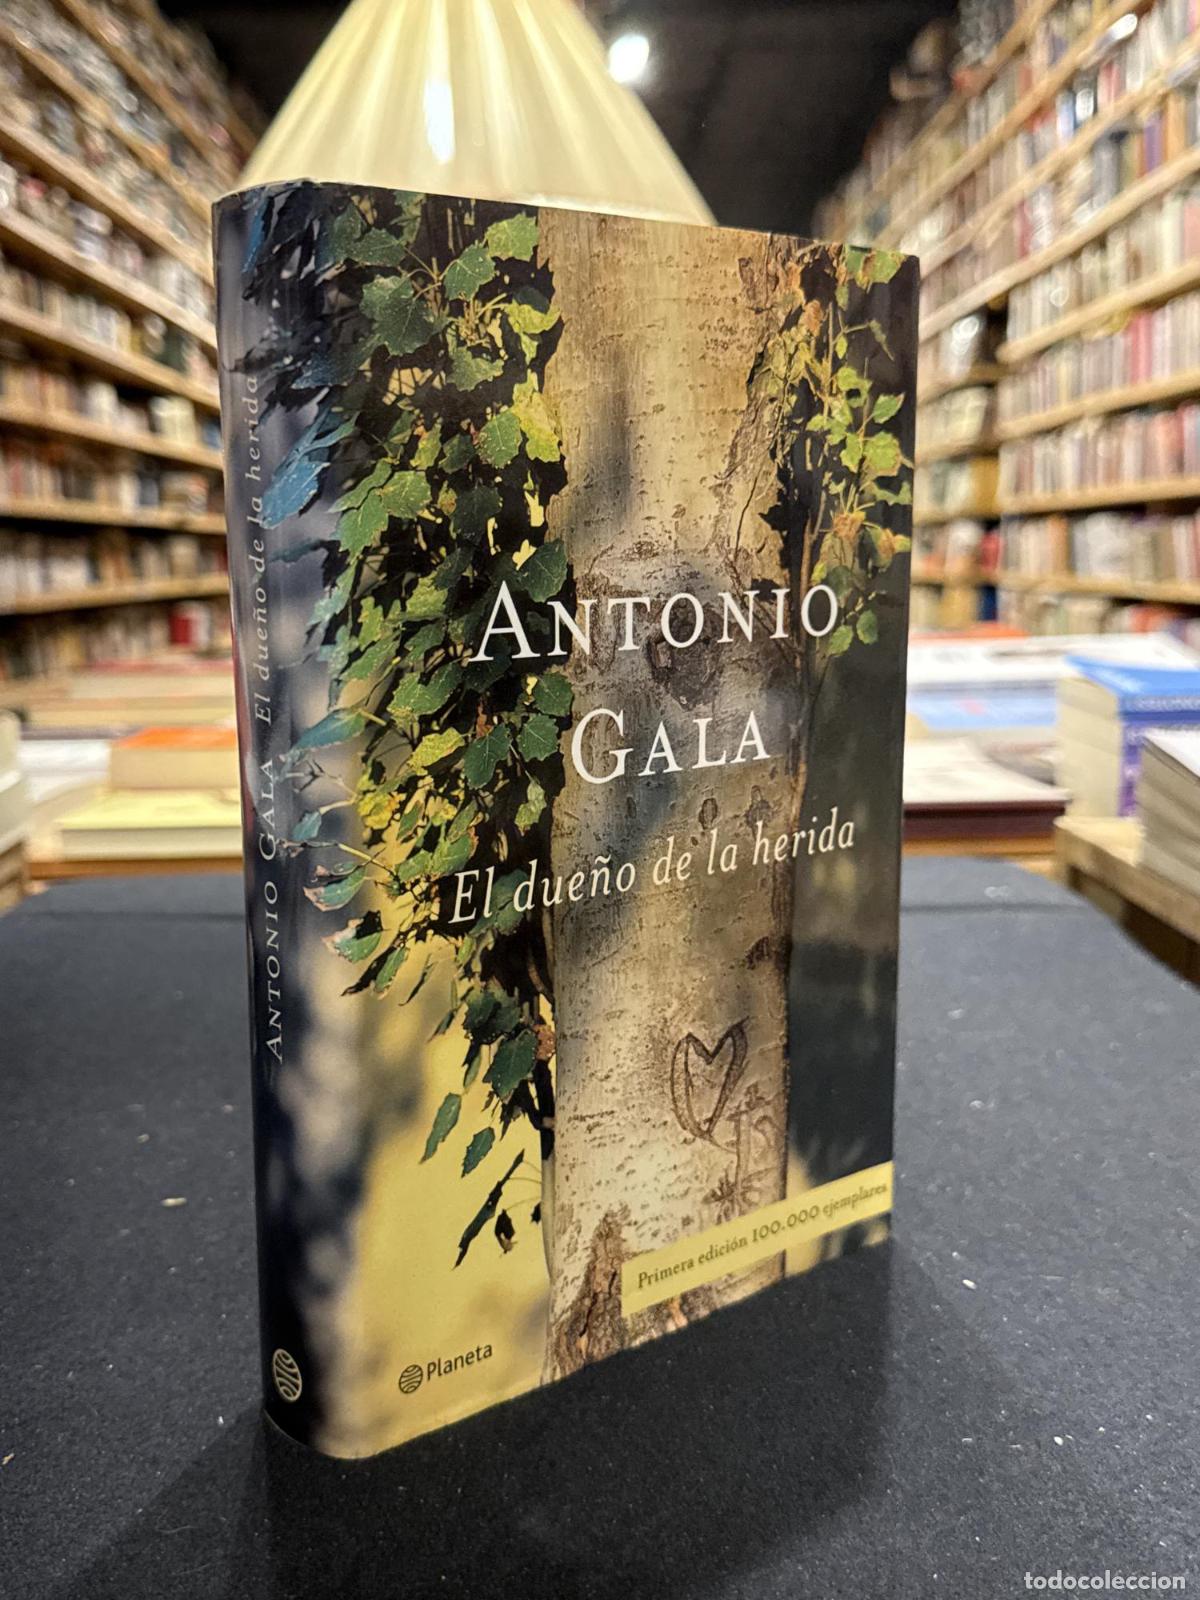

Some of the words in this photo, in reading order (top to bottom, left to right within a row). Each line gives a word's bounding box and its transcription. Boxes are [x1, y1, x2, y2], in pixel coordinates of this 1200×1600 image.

[245, 376, 262, 482] herida
[248, 539, 265, 573] de
[252, 588, 270, 681] dueño
[255, 692, 272, 725] El
[259, 759, 276, 861] GALA
[448, 868, 494, 924] El
[513, 855, 636, 913] dueño
[652, 836, 691, 886] de
[706, 829, 738, 875] la
[752, 806, 855, 866] herida
[265, 881, 283, 1064] ANTONIO
[637, 1258, 695, 1288] Primera
[697, 1236, 748, 1266] edición
[822, 1183, 888, 1218] ejemplares
[426, 1344, 493, 1381] Planeta
